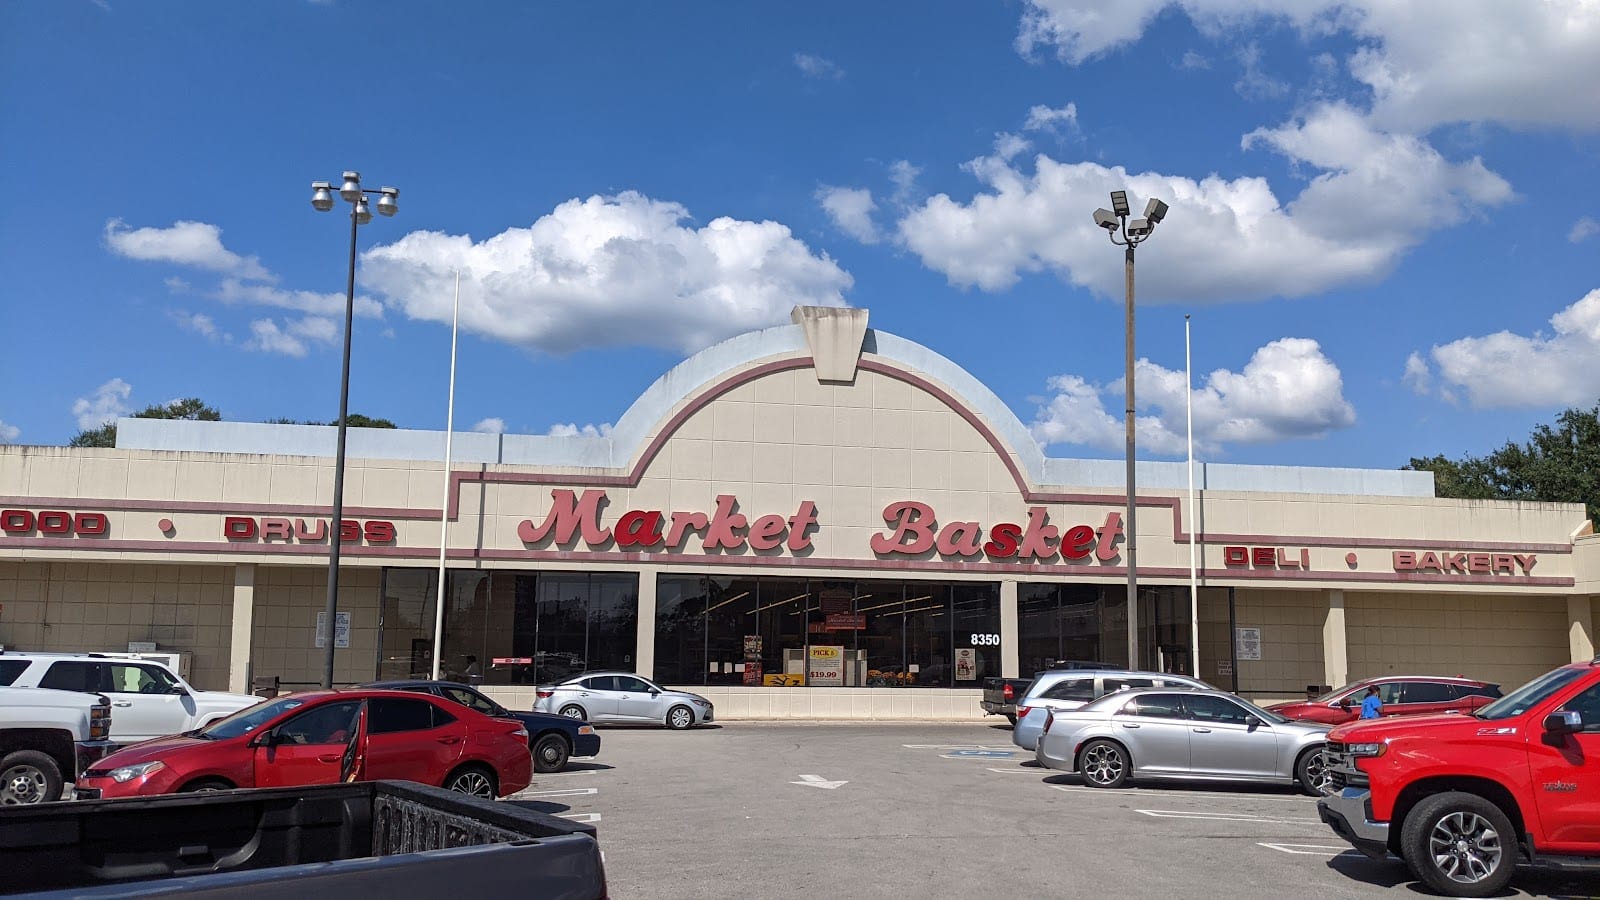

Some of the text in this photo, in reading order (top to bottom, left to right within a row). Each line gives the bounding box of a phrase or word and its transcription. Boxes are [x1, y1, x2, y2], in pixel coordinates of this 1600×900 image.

[224, 516, 394, 542] DRUGS
[517, 488, 1122, 561] Market Basket
[1224, 546, 1537, 573] DELI BAKERY
[970, 633, 1000, 646] 8350
